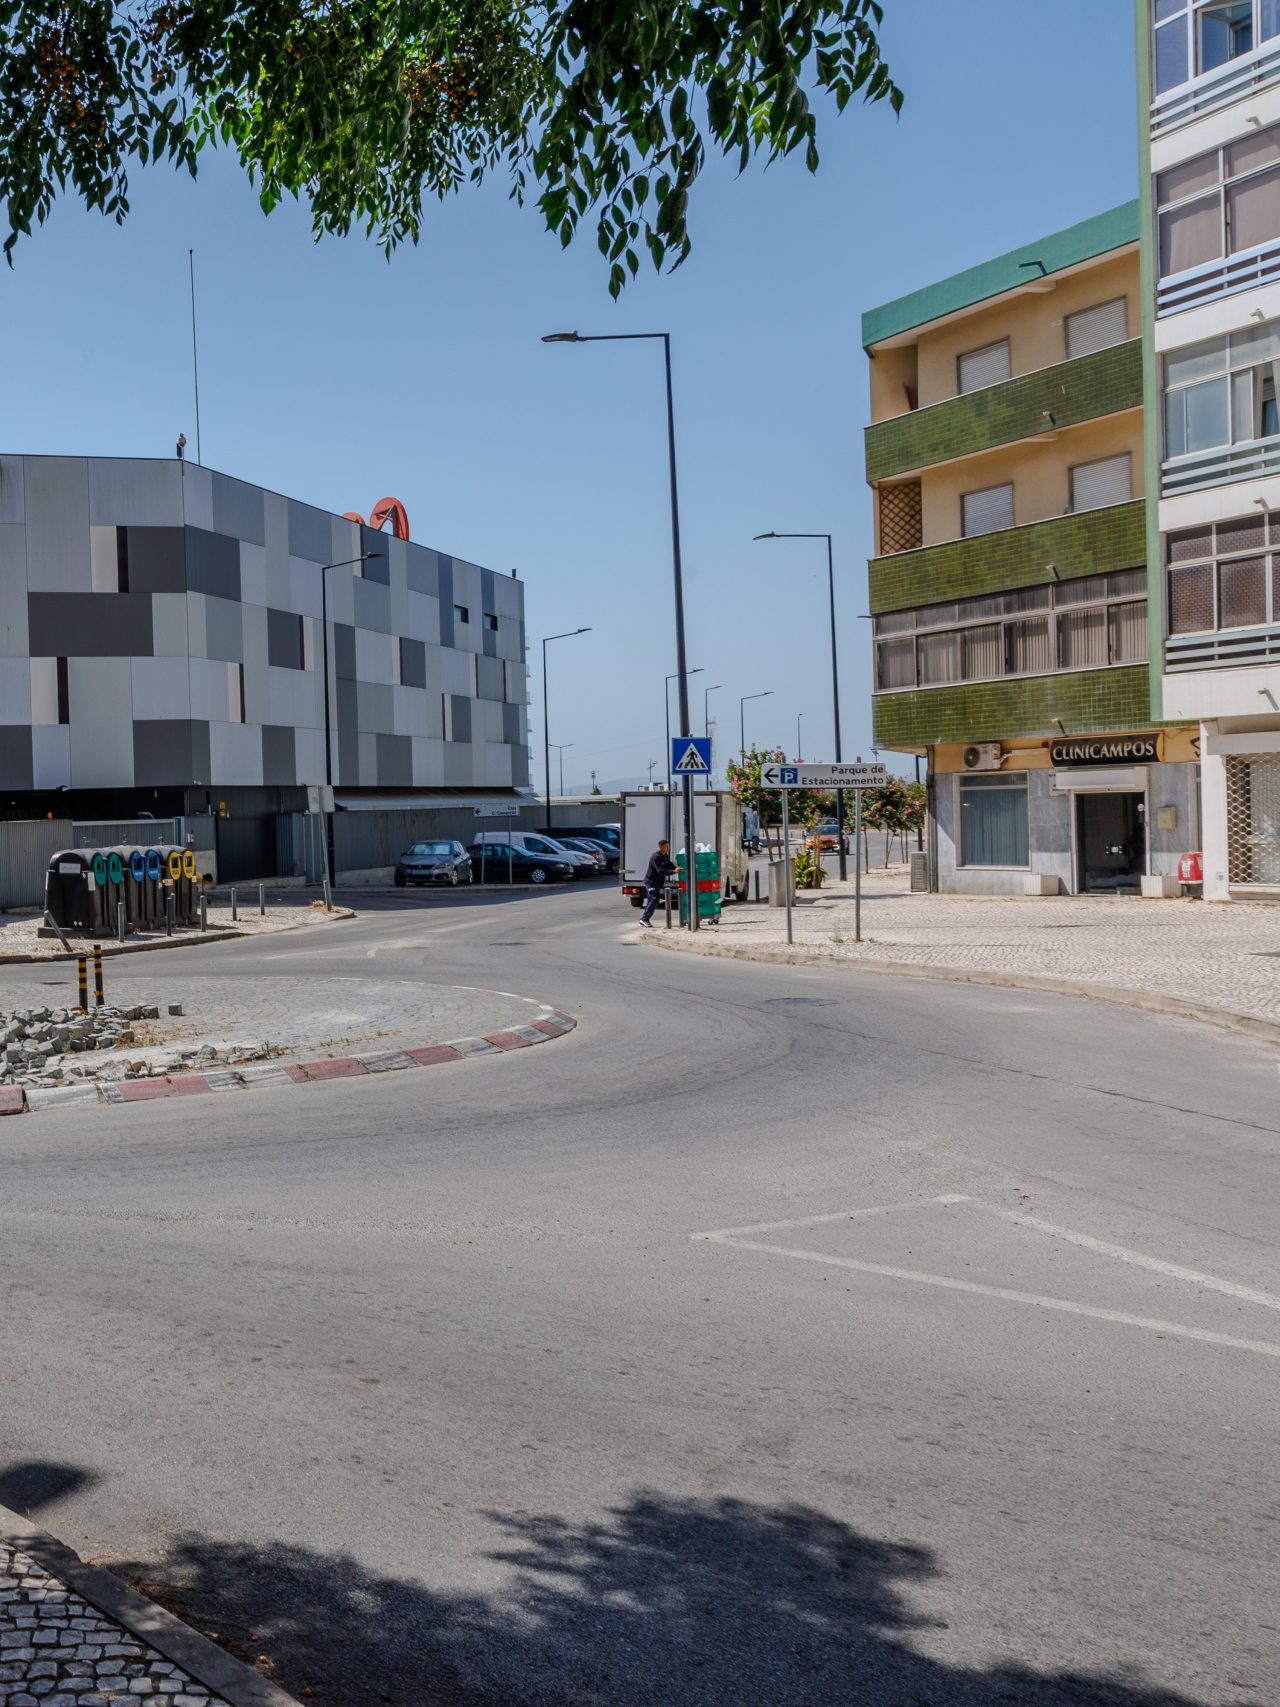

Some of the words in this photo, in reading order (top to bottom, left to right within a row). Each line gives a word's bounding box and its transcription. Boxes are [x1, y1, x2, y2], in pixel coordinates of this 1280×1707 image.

[1052, 741, 1154, 760] CLINICAMPOS
[831, 766, 868, 775] Parque
[871, 765, 884, 773] de
[784, 772, 793, 783] P
[801, 777, 884, 785] Estacionamento
